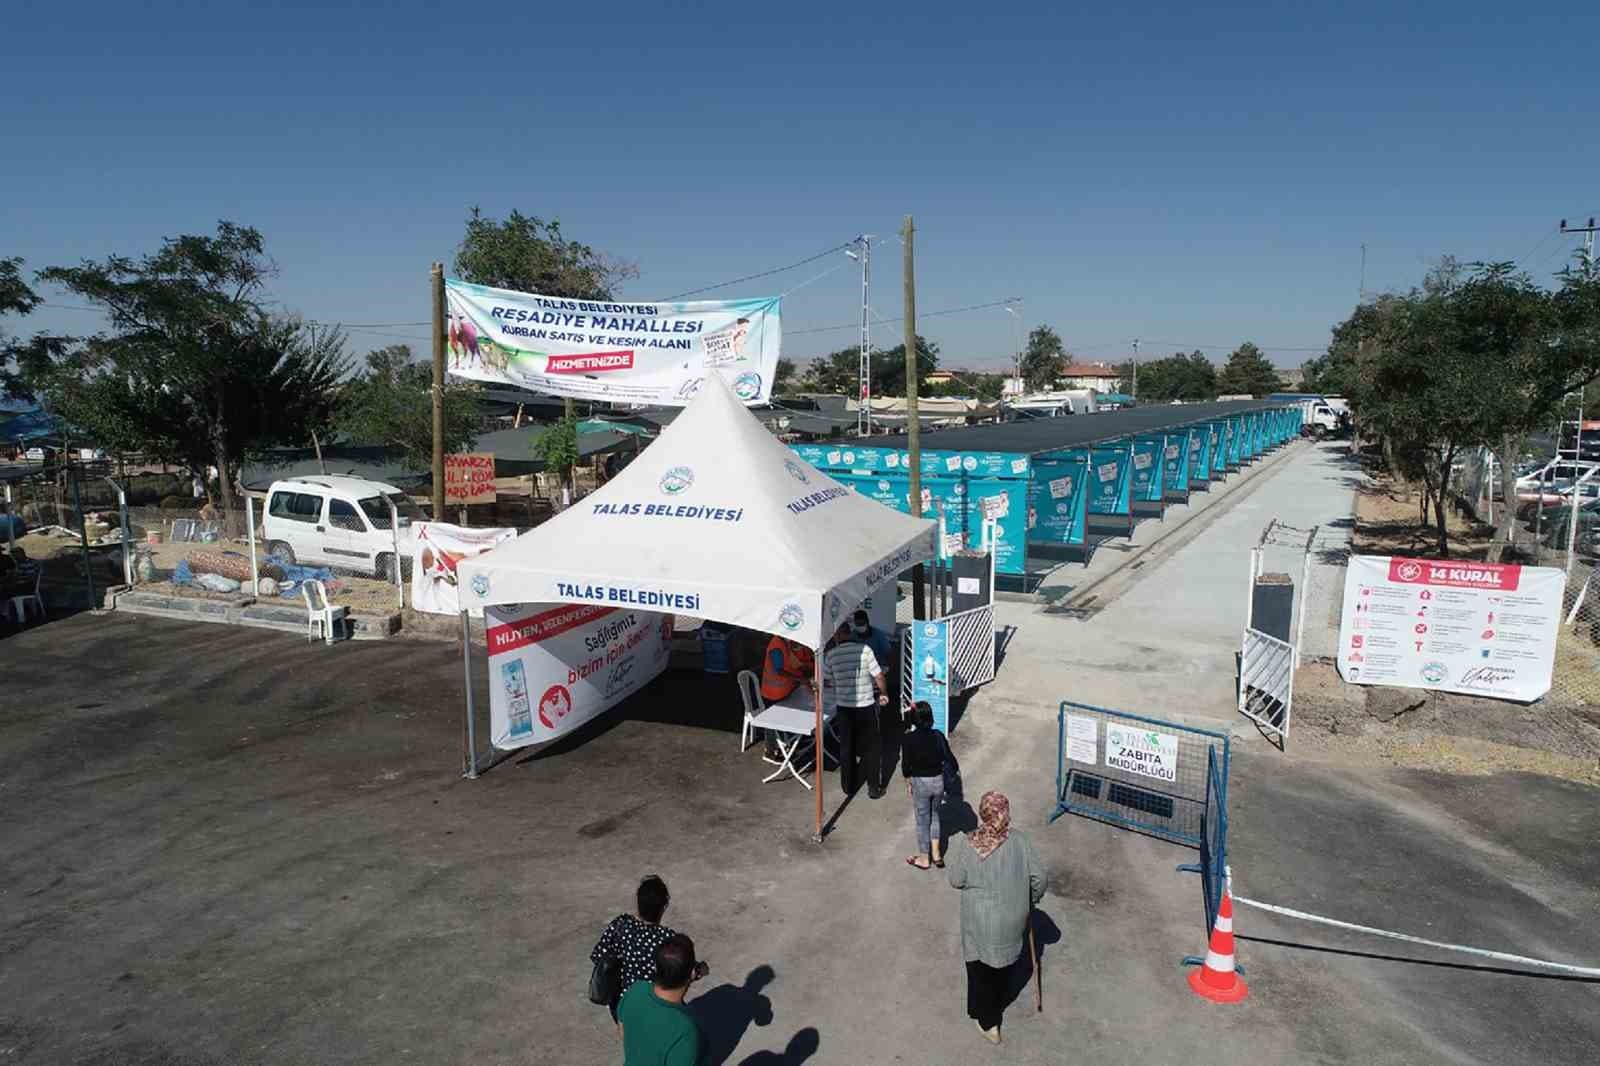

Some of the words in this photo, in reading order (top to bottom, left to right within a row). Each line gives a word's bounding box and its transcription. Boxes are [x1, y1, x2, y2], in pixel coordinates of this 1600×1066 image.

[535, 298, 577, 311] TALAS
[501, 324, 547, 339] KURBAN
[588, 335, 606, 345] VE
[648, 338, 691, 350] ALANI
[592, 503, 642, 515] TALAS
[644, 503, 744, 522] BELEDİYESİ
[1449, 568, 1503, 585] KURAL
[557, 583, 604, 600] TALAS
[608, 588, 700, 610] BELEDİYESİ
[1119, 747, 1162, 765] ZABITA
